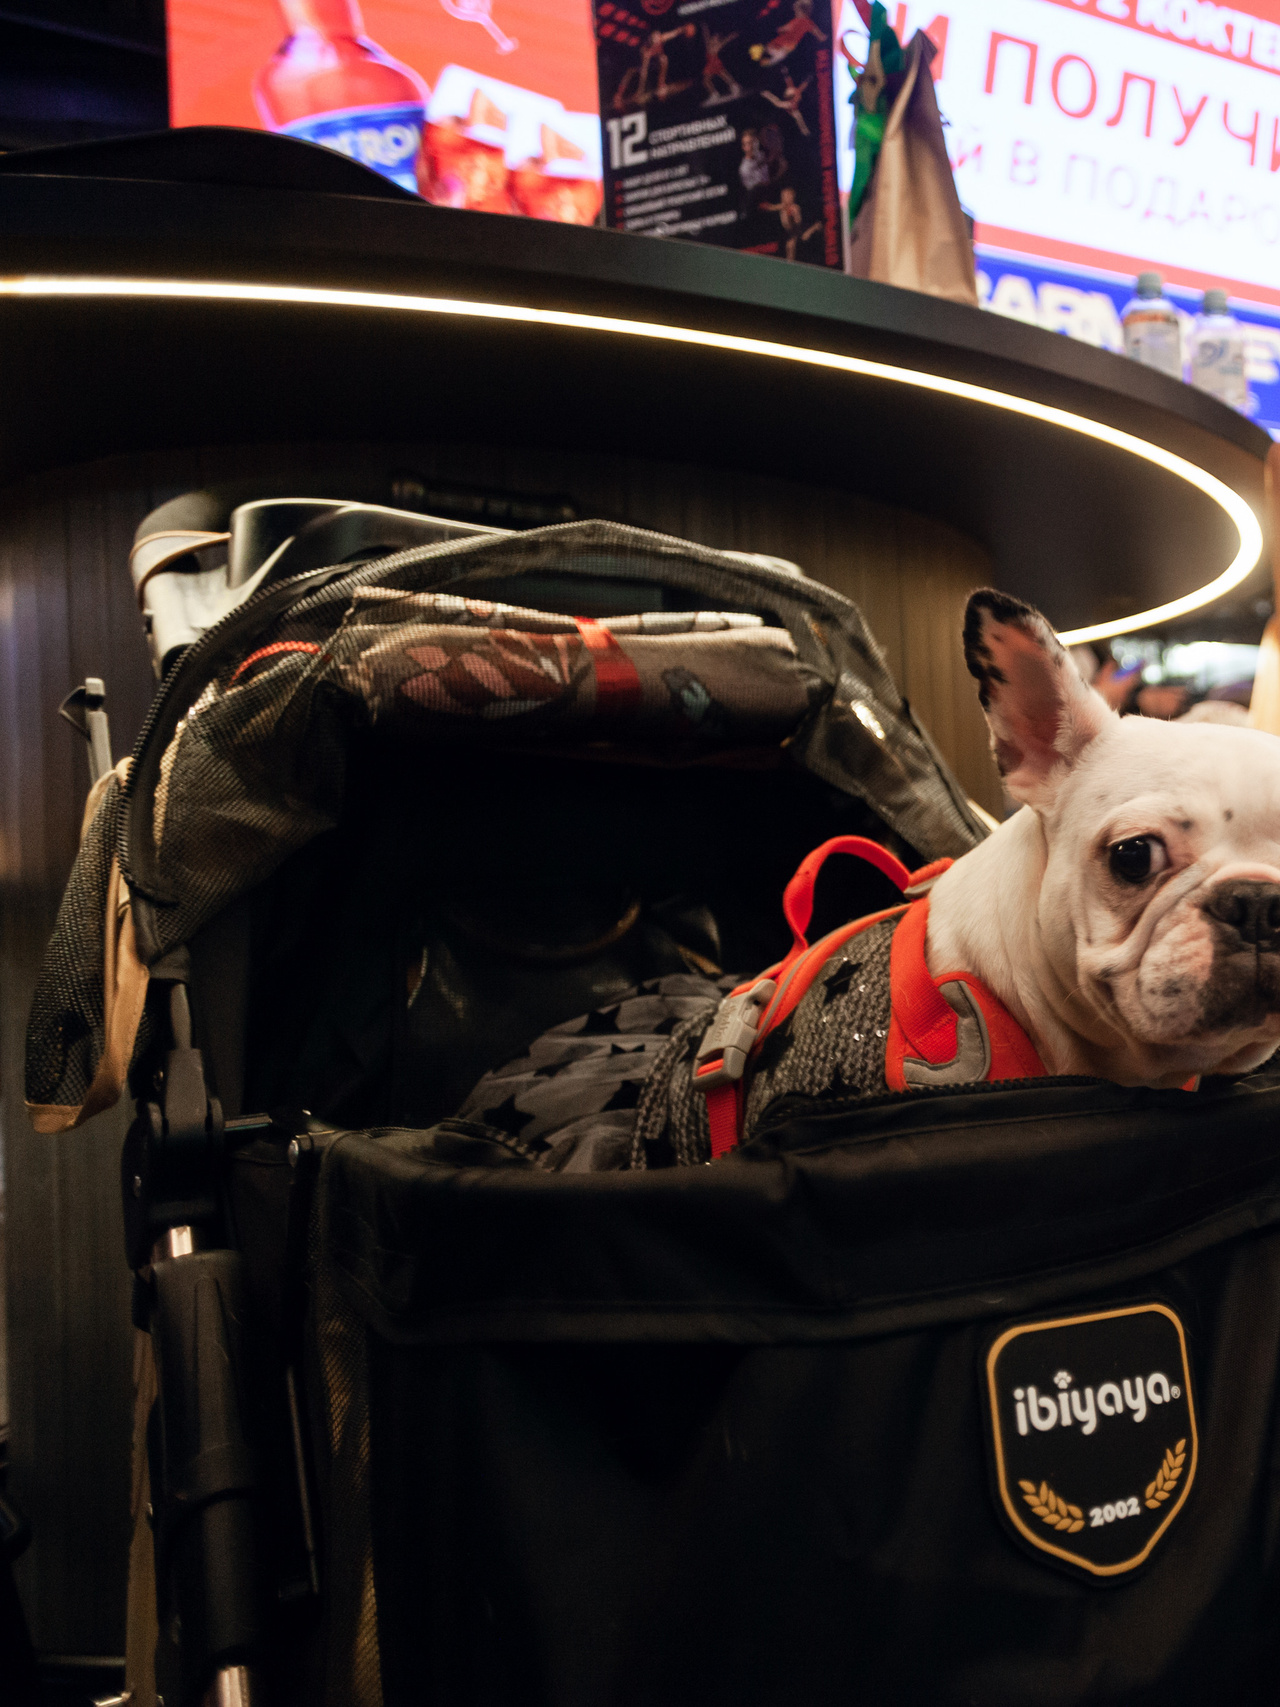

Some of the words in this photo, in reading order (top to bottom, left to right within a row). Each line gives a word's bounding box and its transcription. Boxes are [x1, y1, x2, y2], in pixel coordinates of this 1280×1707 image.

[606, 111, 649, 170] 12
[1010, 138, 1040, 187] В
[1013, 1371, 1171, 1436] ibiyaya
[1089, 1497, 1140, 1527] 2002
